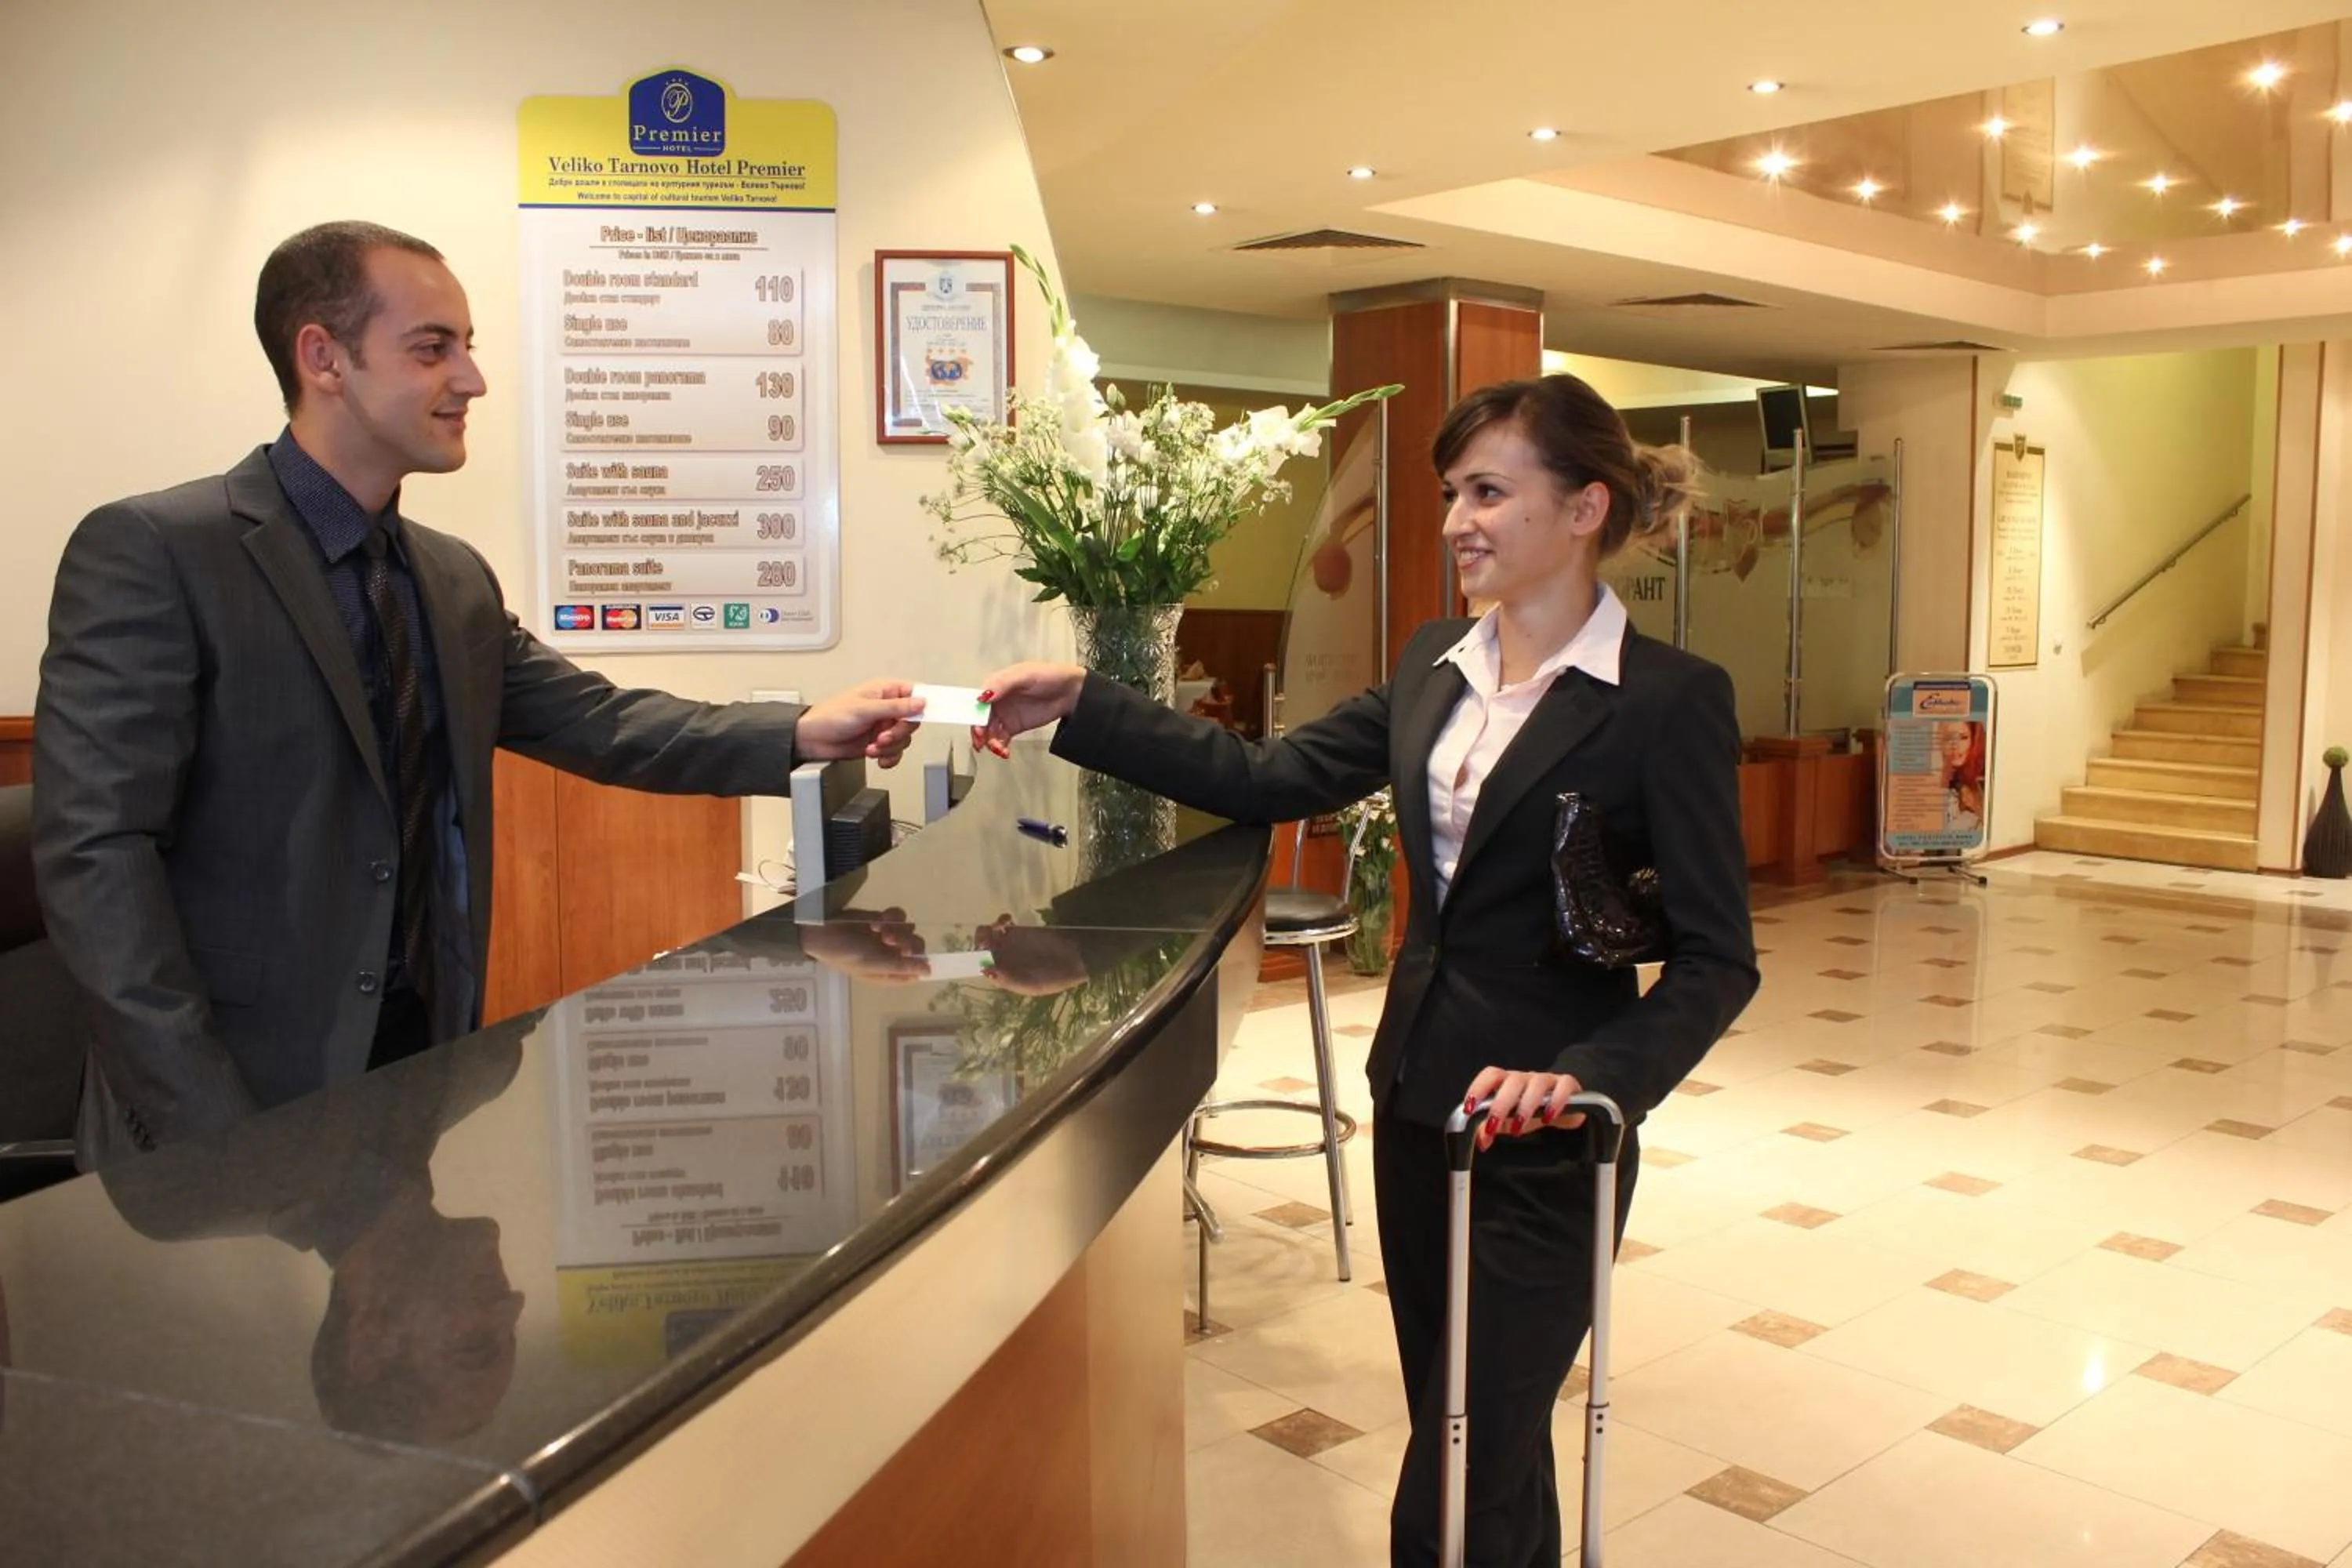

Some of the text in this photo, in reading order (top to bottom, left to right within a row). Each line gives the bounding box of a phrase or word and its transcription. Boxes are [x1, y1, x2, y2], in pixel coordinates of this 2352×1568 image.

[633, 125, 722, 143] Premier
[549, 156, 806, 176] Veliko Tarnovo Hotel Premier
[601, 226, 635, 242] Price
[645, 227, 666, 242] list
[609, 273, 641, 287] room
[755, 275, 794, 303] 110
[564, 314, 628, 335] Single use
[768, 319, 794, 346] 80
[906, 315, 987, 333] УДОСТОВЕРЕНИЕ
[610, 371, 641, 385] room
[756, 372, 794, 398] 130
[564, 412, 630, 431] Single use
[768, 415, 794, 441] 90
[565, 462, 669, 479] Suite with sauna
[755, 466, 796, 491] 250
[567, 510, 599, 528] Suite
[602, 510, 628, 528] with
[632, 514, 668, 528] sauna
[672, 510, 694, 528] and
[757, 513, 796, 539] 300
[632, 558, 663, 575] suite
[655, 612, 680, 622] VISA
